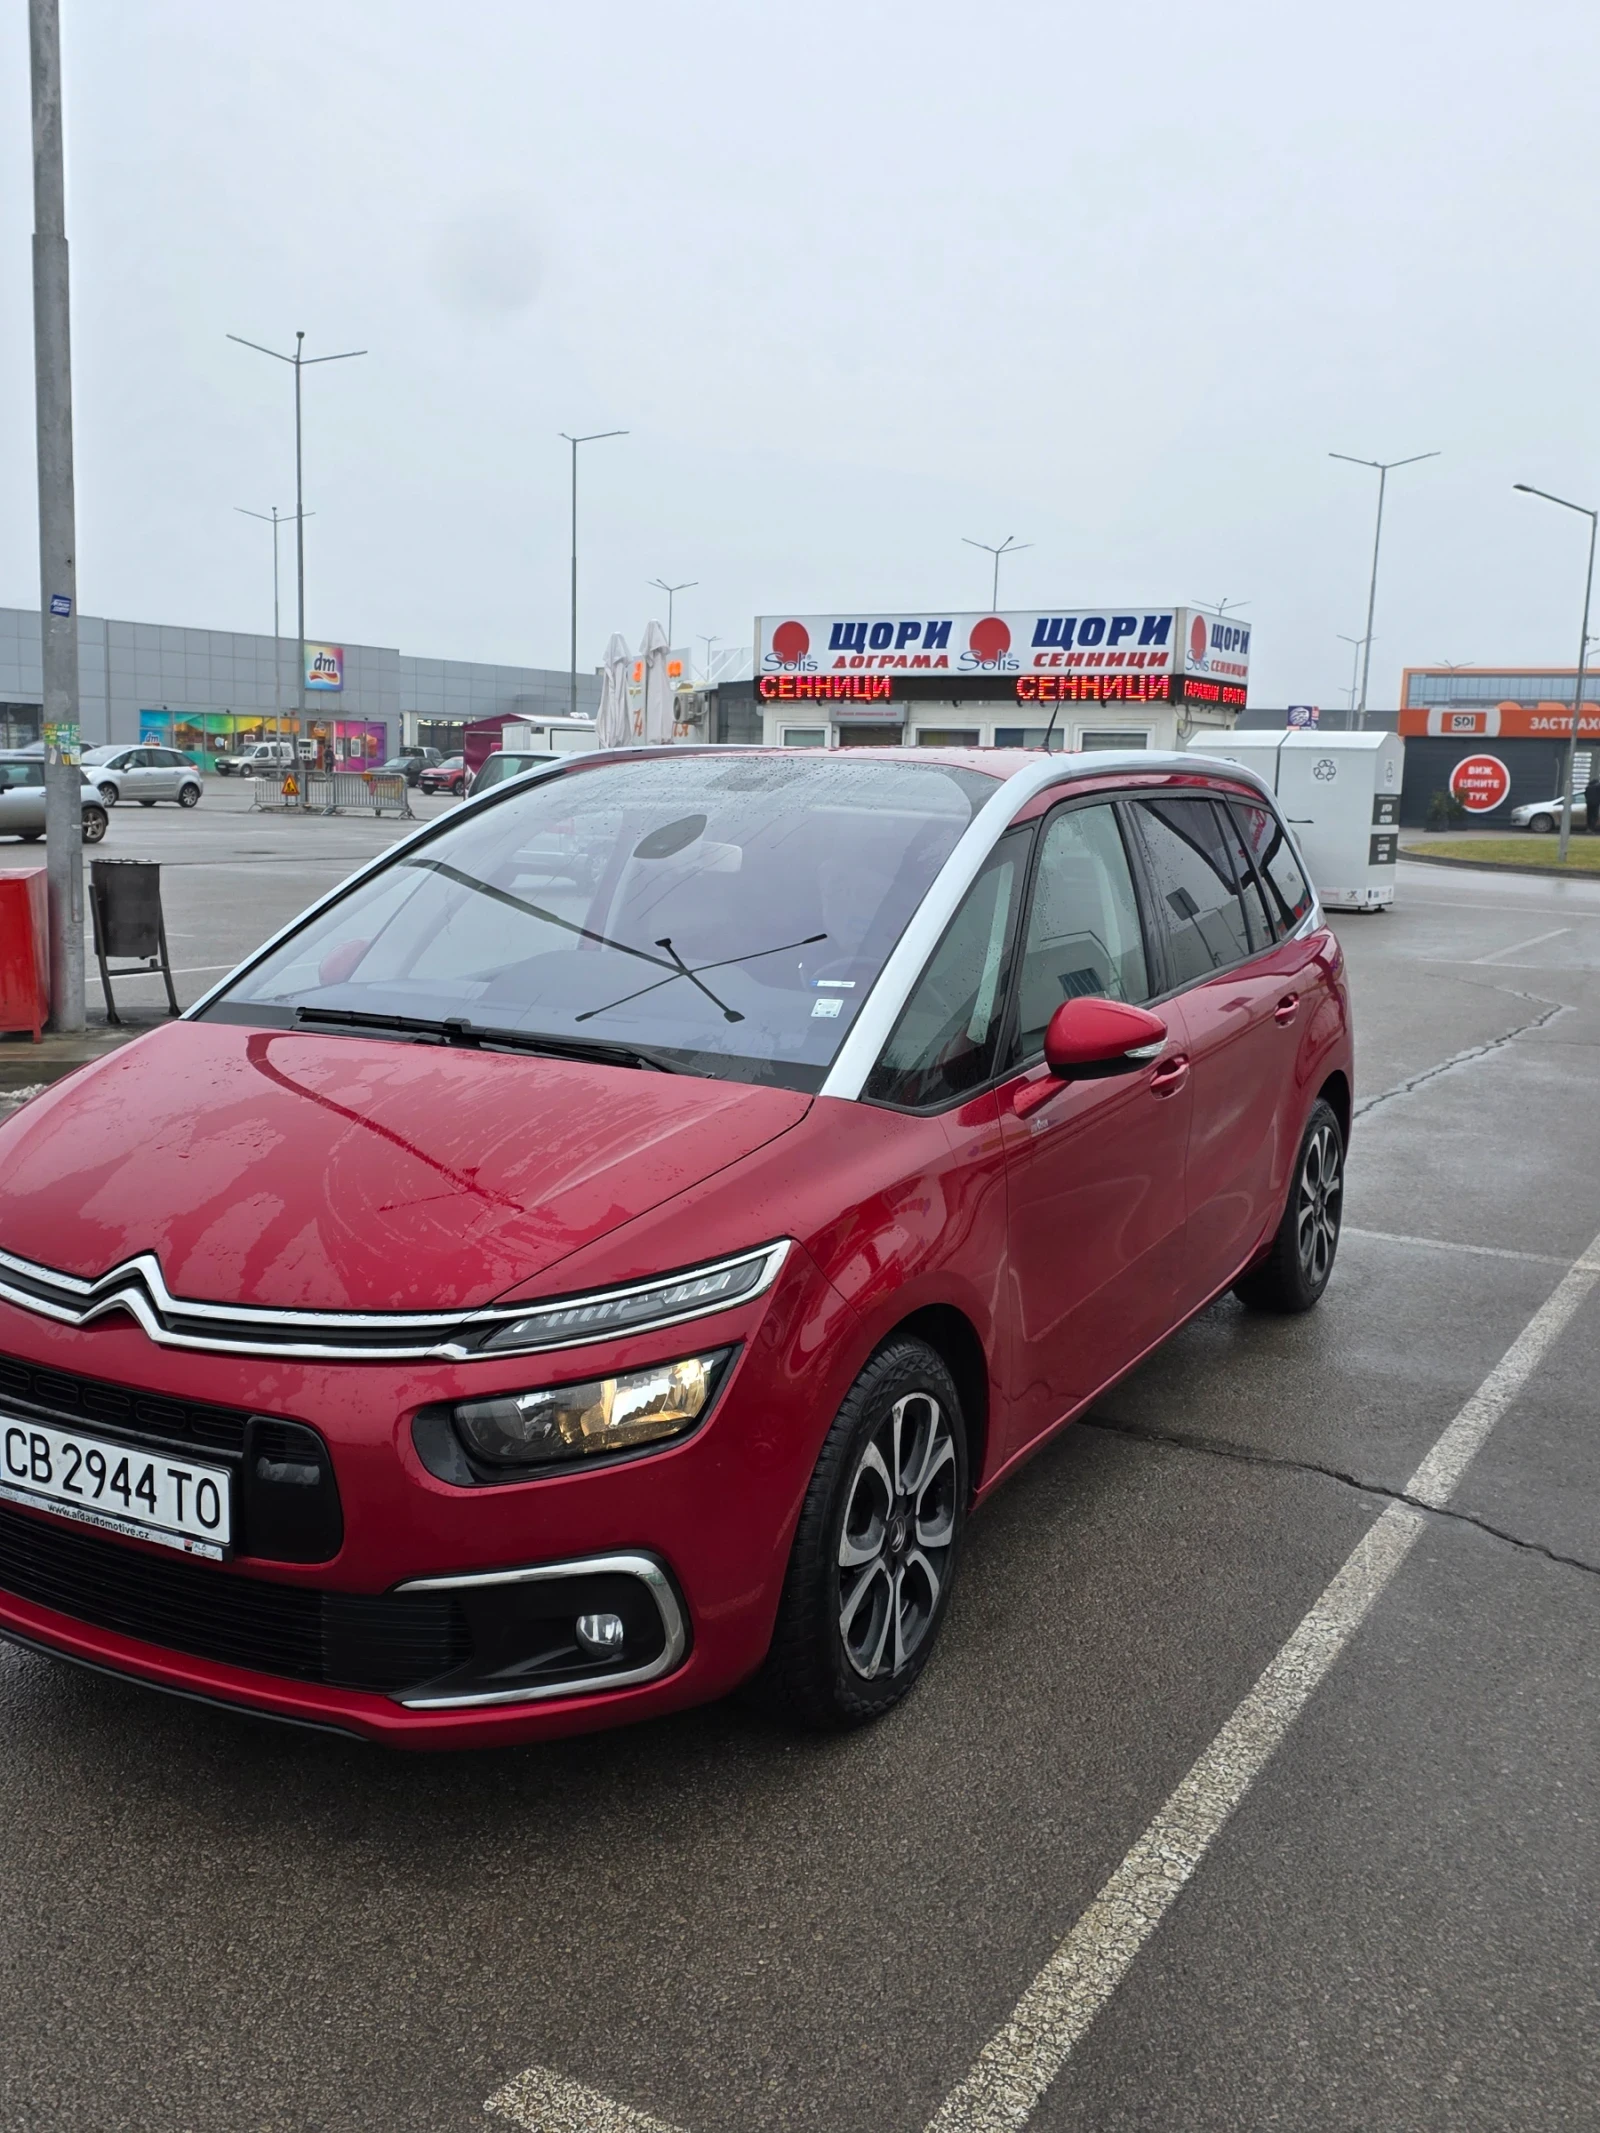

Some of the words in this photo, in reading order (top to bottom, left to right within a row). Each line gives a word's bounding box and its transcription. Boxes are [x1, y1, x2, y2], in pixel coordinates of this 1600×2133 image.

[828, 621, 953, 654] ЩОРИ
[1031, 615, 1173, 651] ЩОРИ
[1210, 623, 1250, 655] ЩОРИ
[314, 652, 336, 672] dm
[762, 651, 818, 672] Solis
[832, 655, 949, 669] ДОГРАМА
[956, 649, 1020, 671] Solis
[1033, 652, 1169, 669] СЕННИЦИ
[759, 675, 891, 700] СЕННИЦИ
[1016, 675, 1169, 702] СЕННИЦИ
[1454, 716, 1475, 727] SDI
[146, 732, 159, 743] dm
[1467, 766, 1493, 775] ВИЖ
[1459, 779, 1500, 789] ЦЕНИТЕ
[1467, 792, 1489, 801] ТУК
[61, 1443, 157, 1515] 2944
